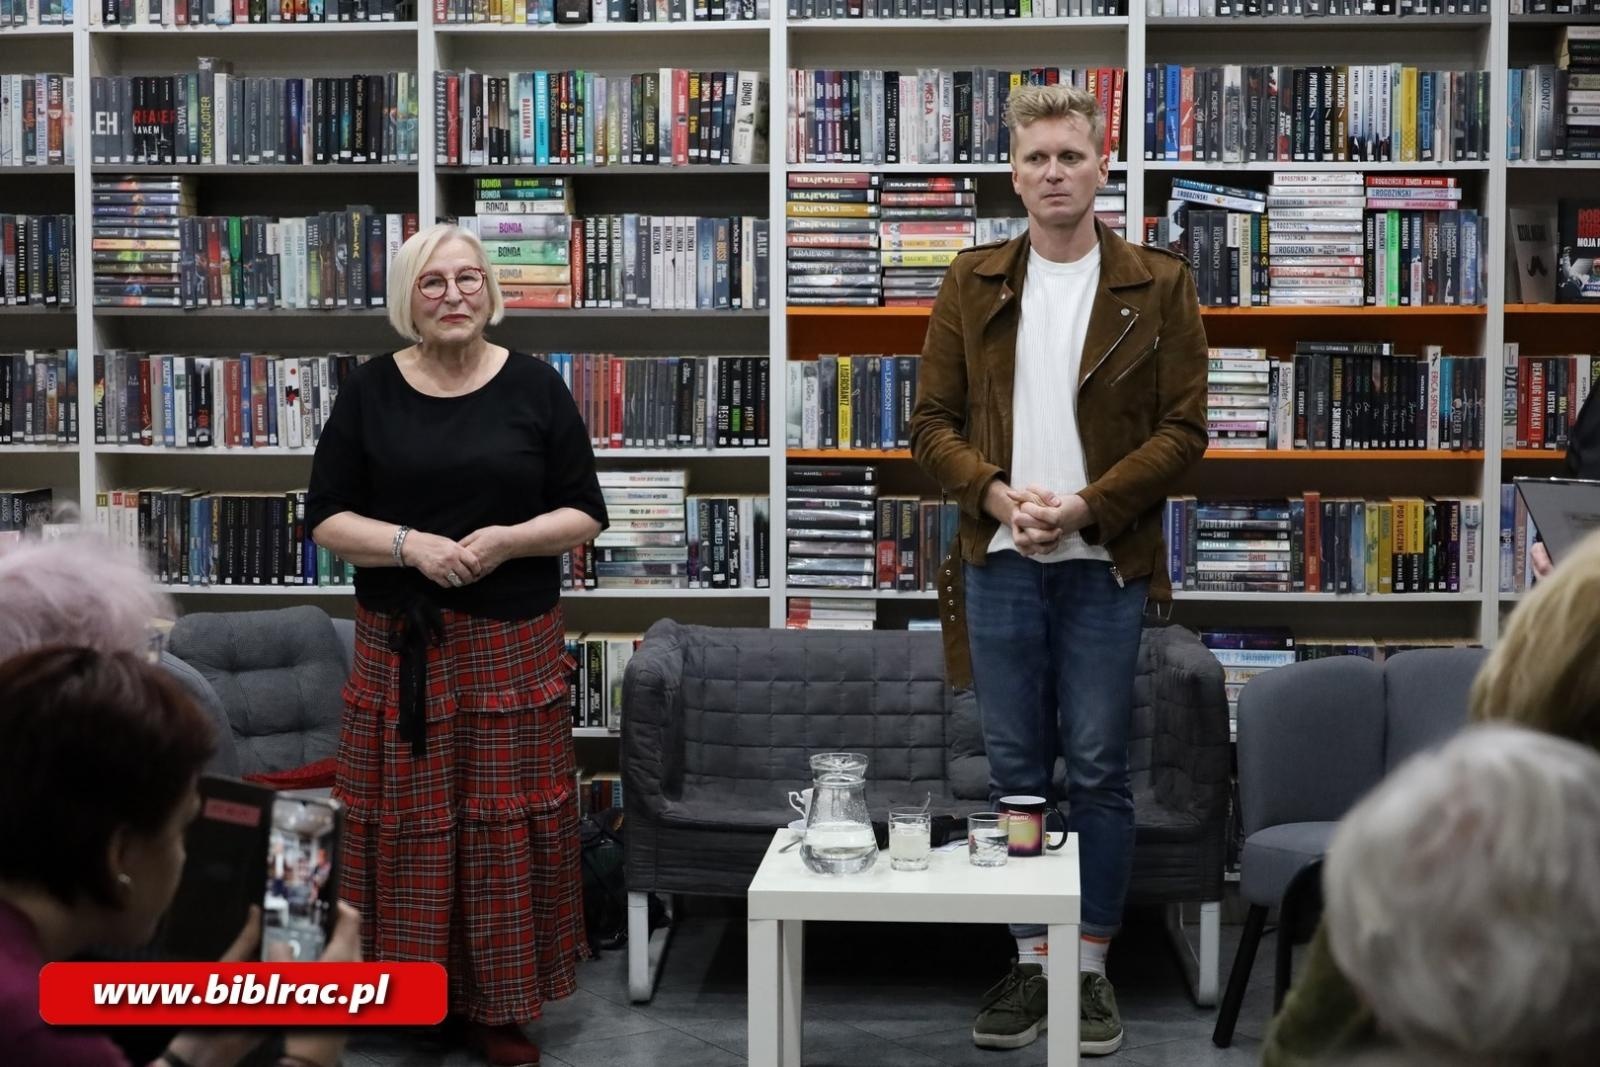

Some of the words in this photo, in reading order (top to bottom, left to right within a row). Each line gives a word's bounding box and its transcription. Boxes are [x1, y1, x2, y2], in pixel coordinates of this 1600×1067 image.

[741, 82, 754, 107] BONDA
[1541, 76, 1551, 112] KOONTZ
[1112, 90, 1121, 138] ERYNIE
[200, 97, 213, 164] OLEKCJONER
[481, 179, 502, 188] BONDA
[796, 176, 844, 185] KRAJEWSKI
[480, 190, 501, 198] BONDA
[792, 189, 840, 200] KRAJEWSKI
[485, 202, 509, 212] BONDA
[792, 203, 840, 213] KRAJEWSKI
[499, 222, 523, 234] BONDA
[586, 217, 595, 238] PIOTR
[599, 217, 608, 238] PIOTR
[792, 233, 840, 244] KRAJEWSKI
[498, 246, 521, 257] BONDA
[586, 239, 595, 264] BORLIK
[599, 239, 608, 265] BORLIK
[757, 231, 767, 258] LALKI
[792, 250, 834, 259] KRAJEWSKI
[839, 364, 850, 407] LAGERCRANTZ
[1532, 362, 1542, 396] DEKALOG
[884, 371, 892, 411] LARSSON
[1504, 366, 1517, 427] DZIEKAN
[1531, 396, 1542, 430] NAWAŁKI
[1559, 396, 1567, 414] KOSA
[728, 505, 736, 542] ĆWIRLEJ
